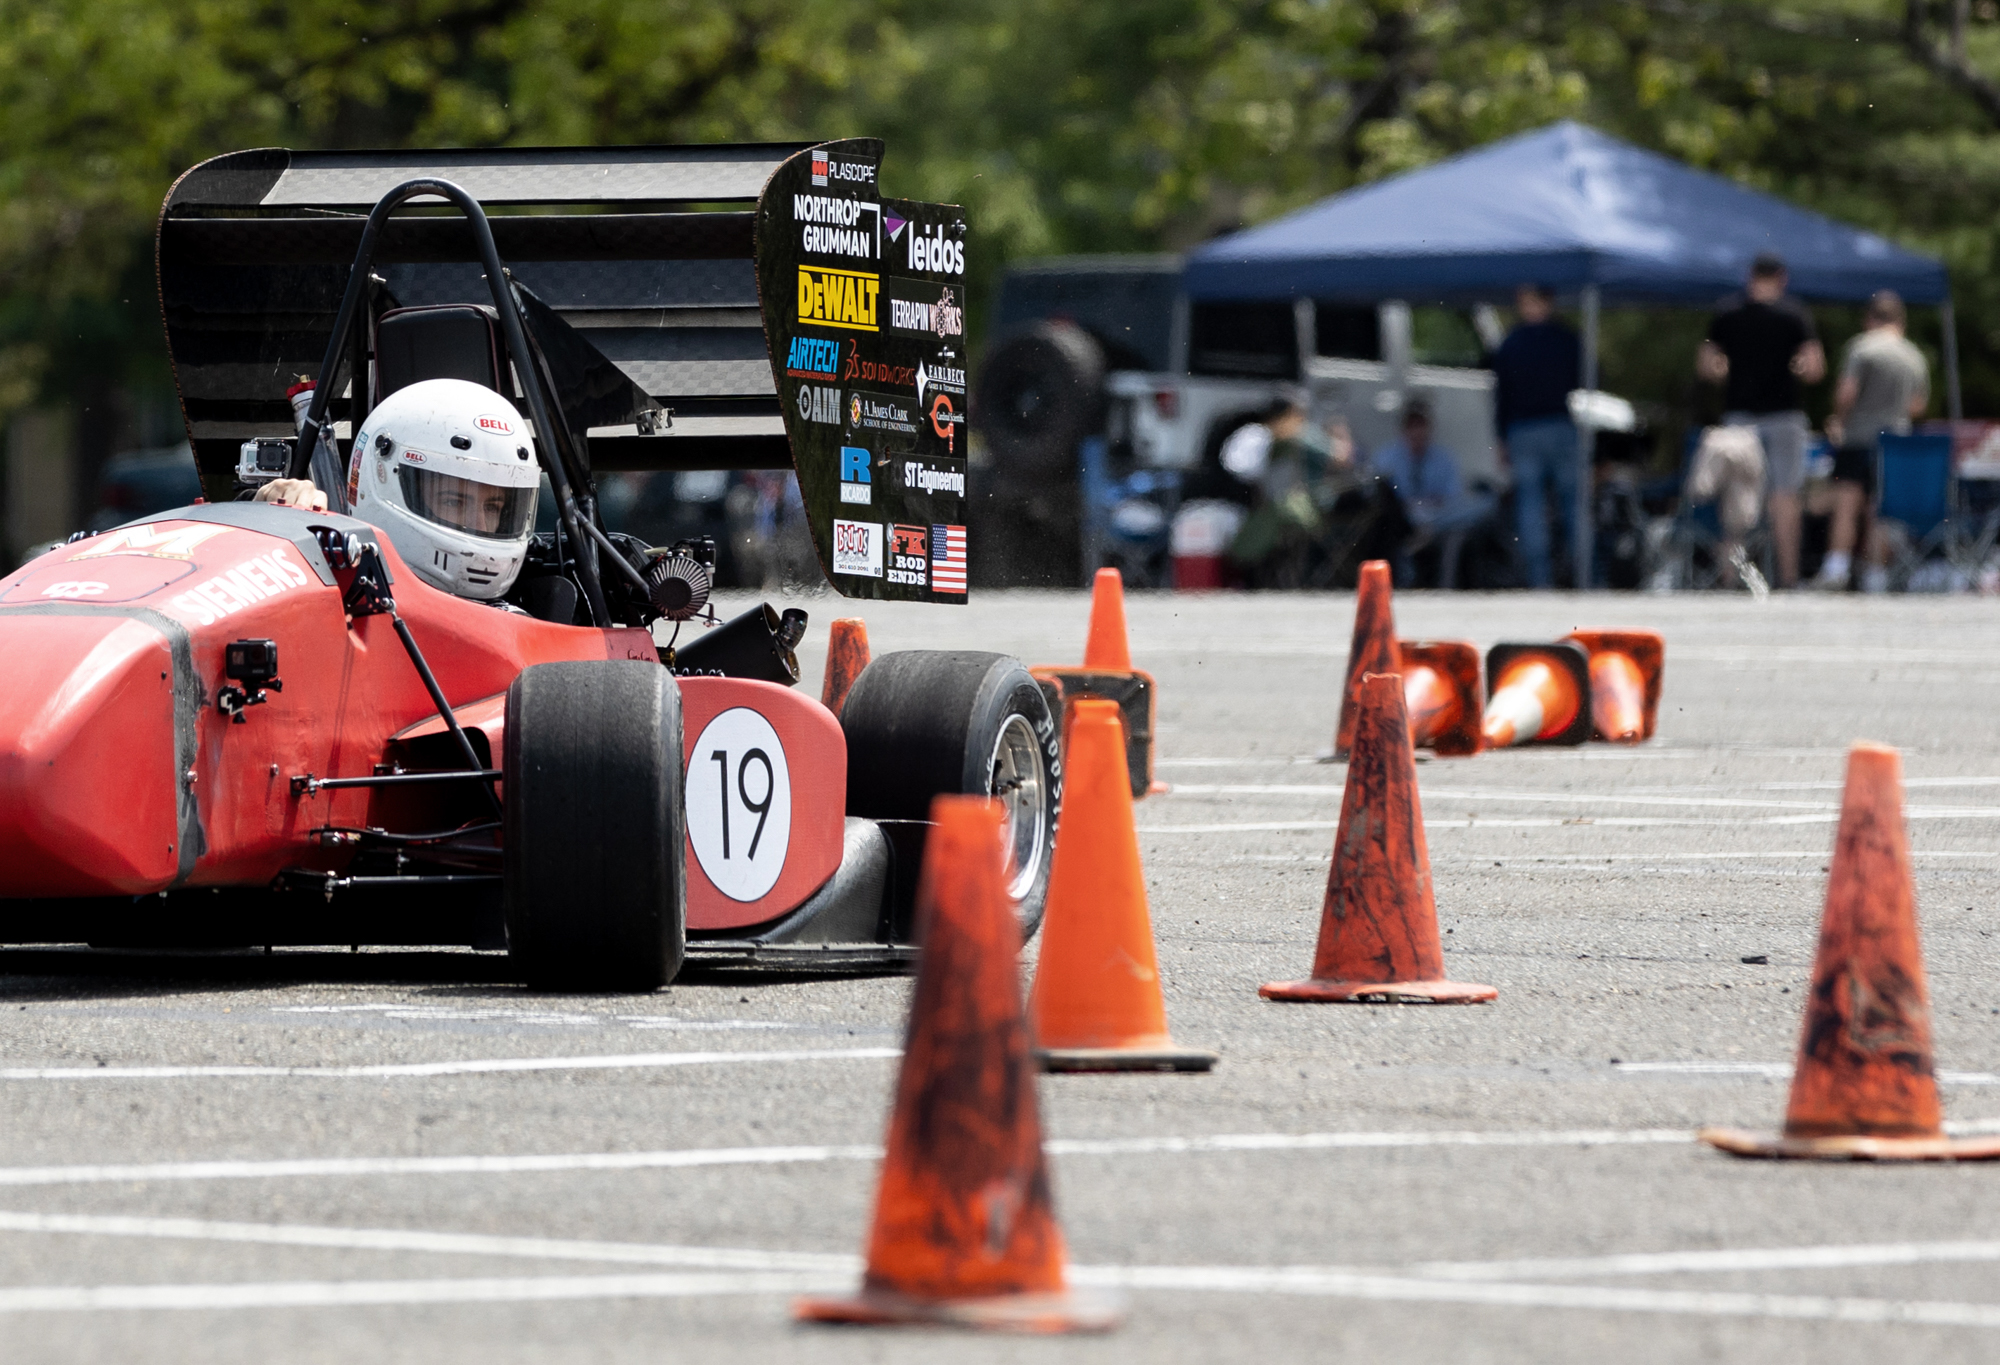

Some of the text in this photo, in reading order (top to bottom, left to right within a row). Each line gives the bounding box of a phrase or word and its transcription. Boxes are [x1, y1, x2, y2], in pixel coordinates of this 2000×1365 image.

[829, 161, 875, 184] PLASCOPE
[794, 194, 861, 226] NORTHROP
[803, 224, 870, 258] GRUMMAN
[908, 220, 965, 275] leidos
[891, 299, 962, 338] TERRAPIN WORKS
[786, 336, 840, 374] AIRTECH
[861, 361, 916, 386] SOLIDWORKS
[928, 364, 965, 384] EARLBECK
[811, 386, 841, 425] AIM
[888, 403, 908, 421] CLARK
[480, 418, 511, 432] BELL
[863, 418, 917, 433] SCHOOL OF ENGINEERING
[405, 452, 424, 462] BELL
[904, 461, 965, 498] ST Engineering
[841, 485, 871, 502] RICARDO
[891, 529, 926, 556] FK
[895, 555, 926, 571] ROD
[171, 548, 308, 627] SIEMENS
[887, 569, 926, 586] ENDS
[710, 747, 774, 861] 19
